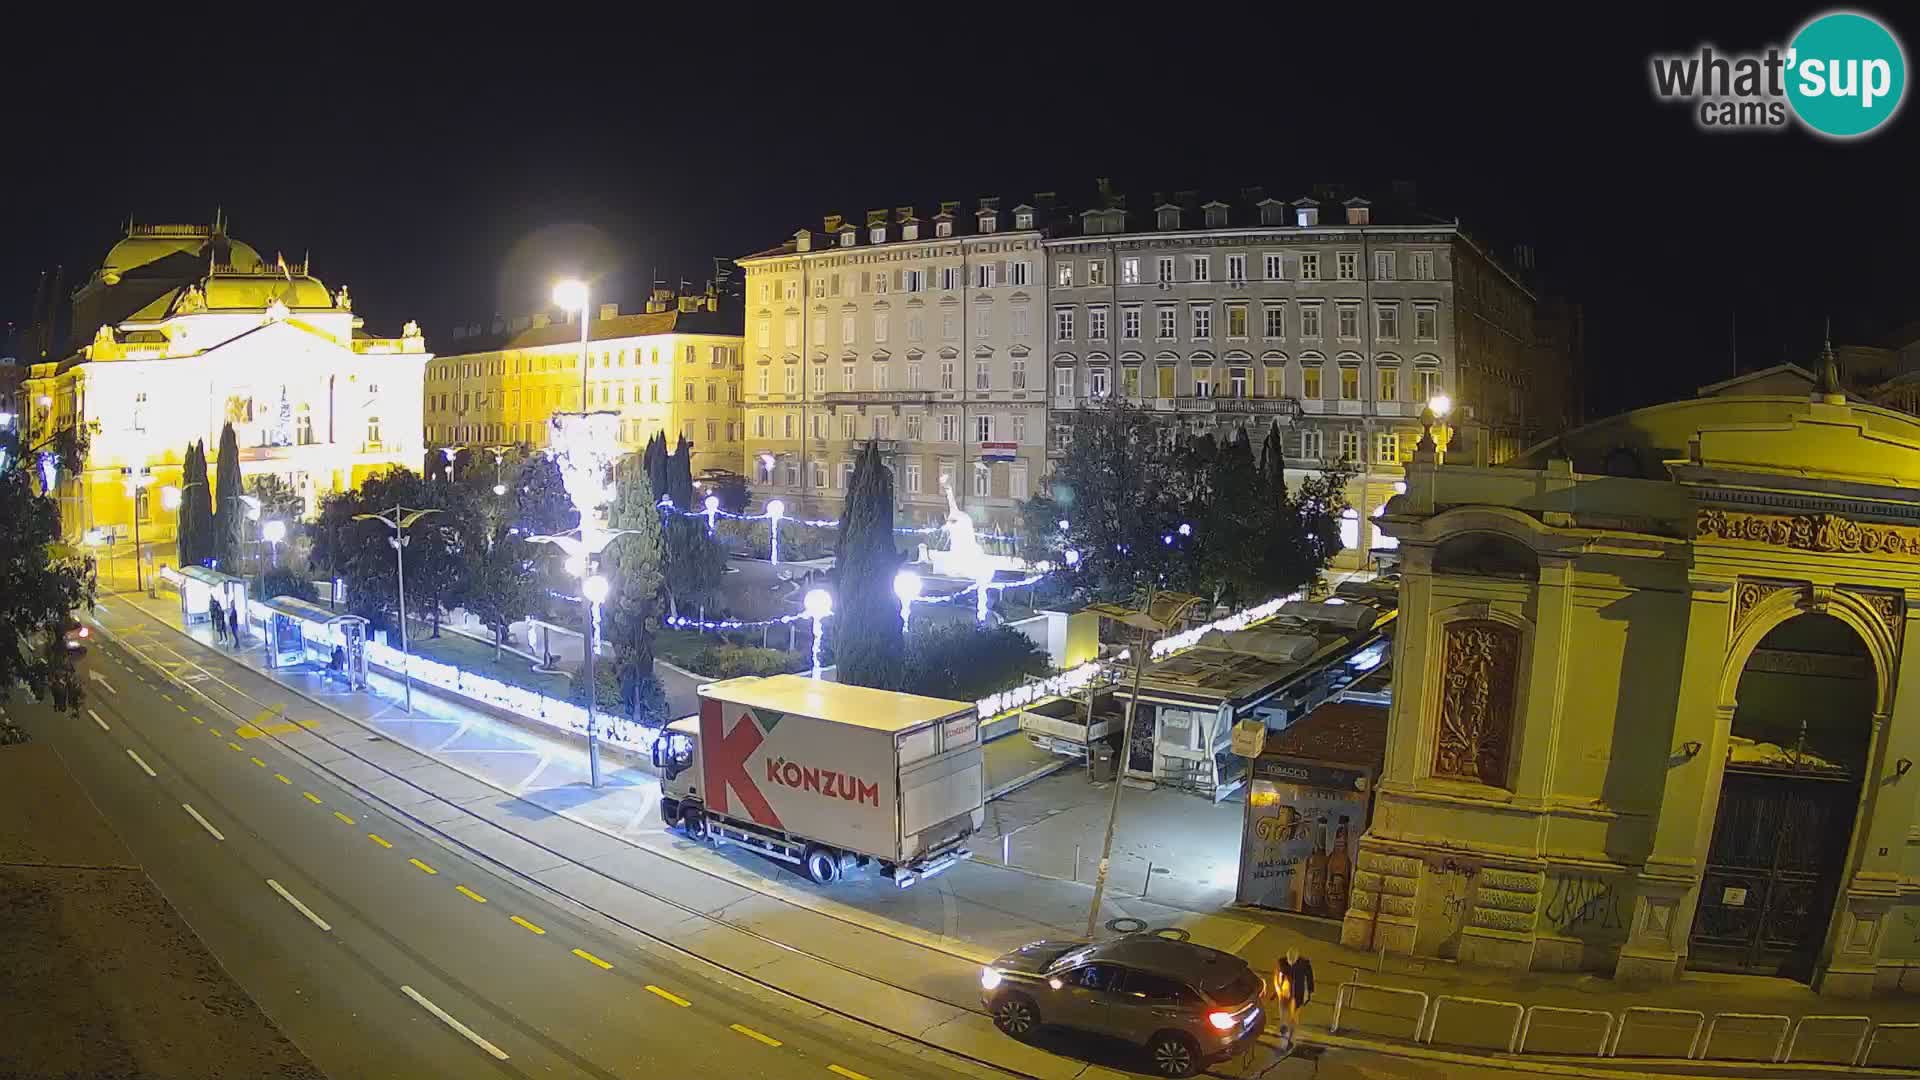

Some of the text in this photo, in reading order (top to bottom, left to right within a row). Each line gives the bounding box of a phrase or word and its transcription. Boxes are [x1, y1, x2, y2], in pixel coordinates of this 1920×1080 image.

[702, 698, 786, 830] K
[767, 756, 879, 807] KONZUM
[1267, 764, 1309, 778] TOBACCO
